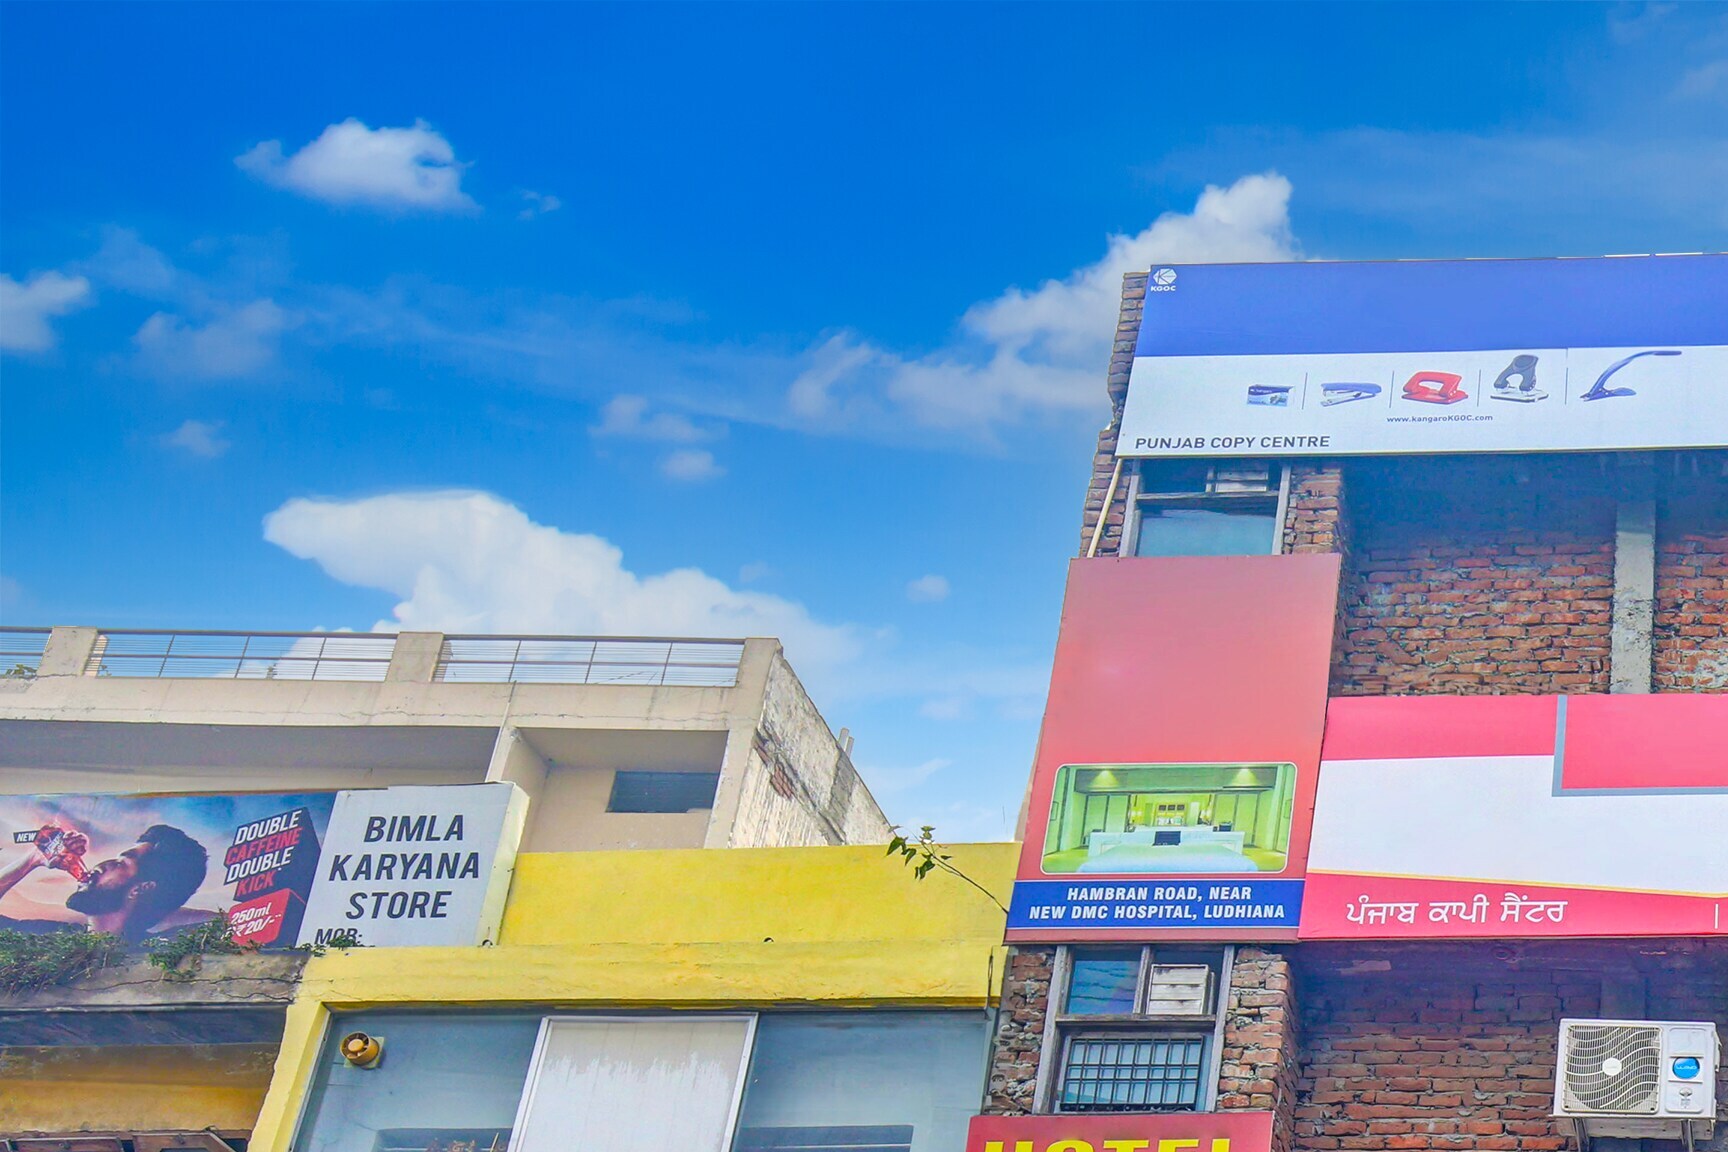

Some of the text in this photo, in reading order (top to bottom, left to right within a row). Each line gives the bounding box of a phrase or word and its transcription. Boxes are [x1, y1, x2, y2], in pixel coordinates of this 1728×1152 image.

[1135, 436, 1331, 449] PUNJAB COPY CENTRE
[16, 832, 37, 842] NEW
[235, 810, 302, 845] DOUBLE
[364, 815, 464, 842] BIMLA
[226, 828, 302, 865] CAFFEINE
[226, 846, 294, 883] DOUBLE
[329, 852, 479, 881] KARYANA
[236, 870, 276, 897] KICK
[1067, 886, 1252, 902] HAMBRAN ROAD, NEAR
[346, 891, 451, 918] STORE
[1029, 904, 1285, 920] NEW DMC HOSPITAL, LUDHIANA
[1346, 895, 1419, 925] ਪੰਜਾਬ
[1429, 893, 1490, 924] ਕਾਪੀ
